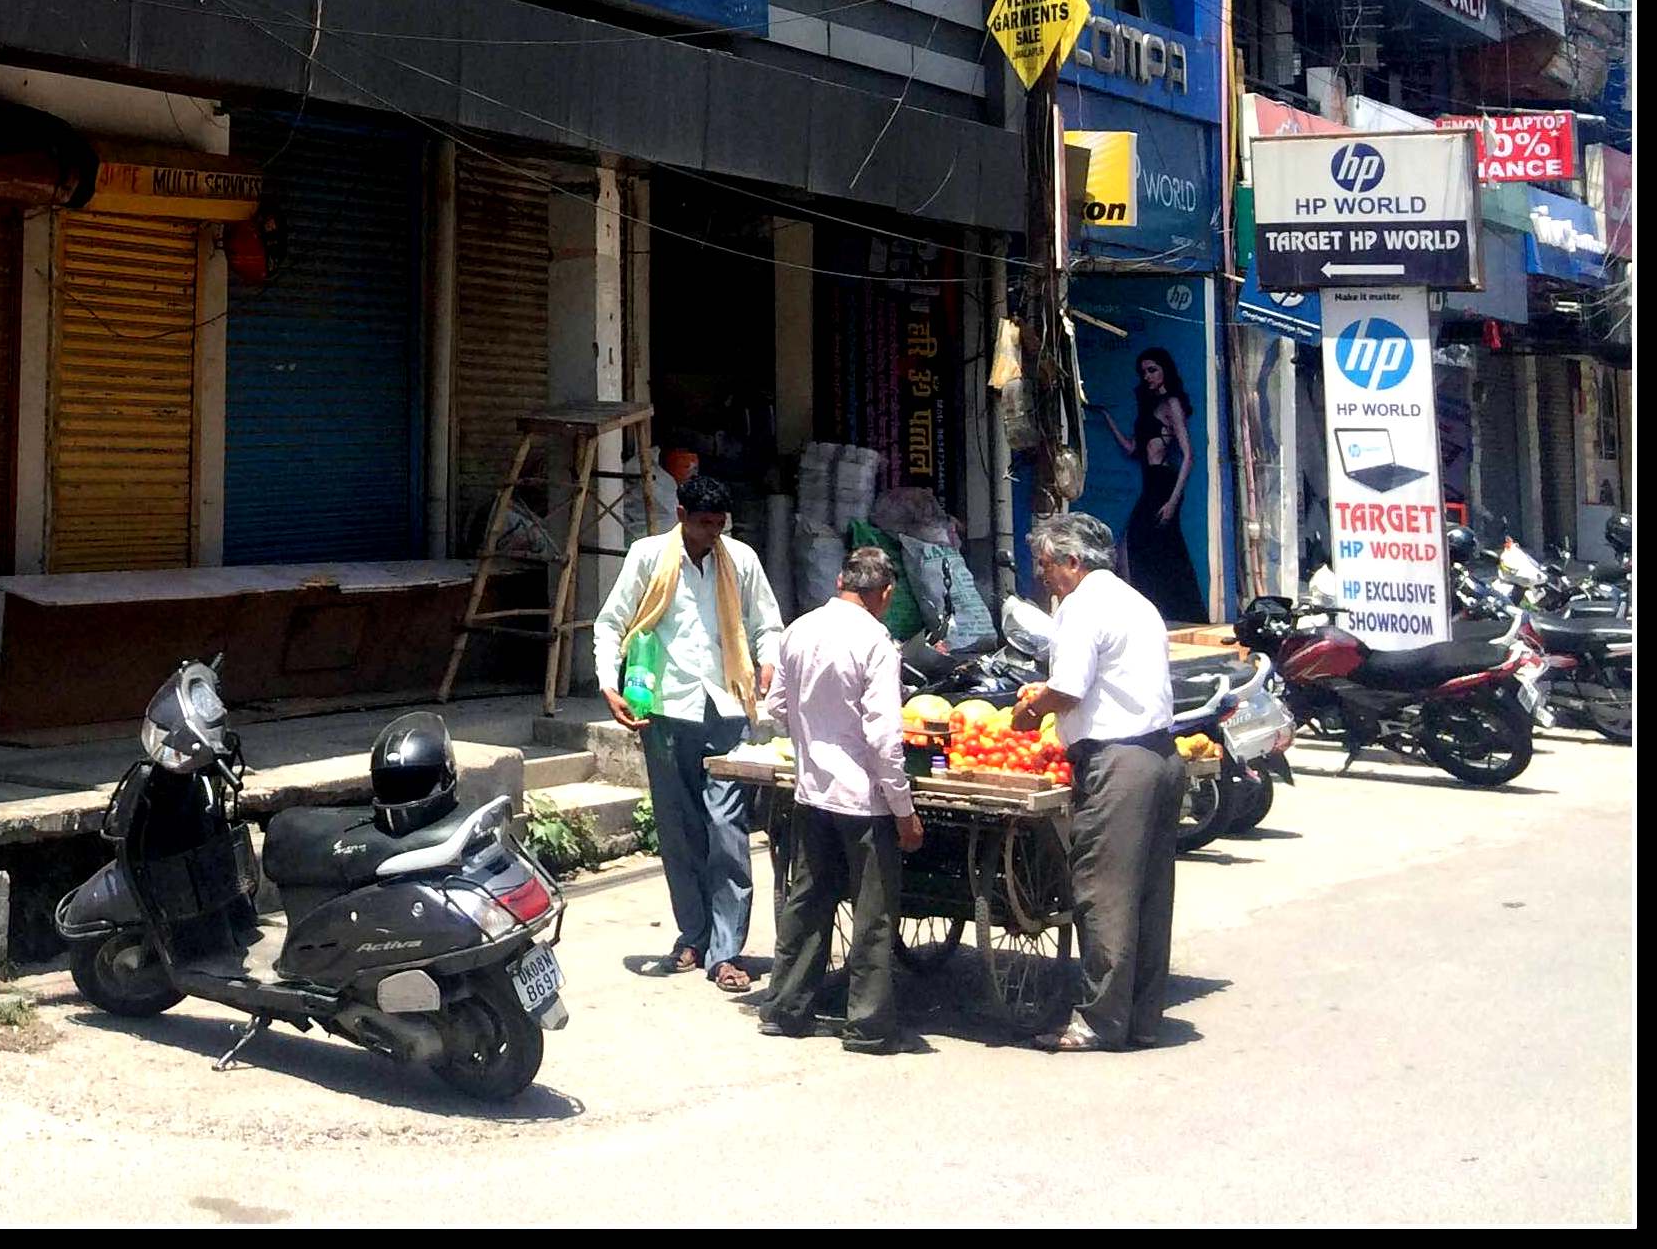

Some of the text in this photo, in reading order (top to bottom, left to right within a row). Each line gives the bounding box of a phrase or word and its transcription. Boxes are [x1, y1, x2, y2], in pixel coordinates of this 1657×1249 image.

[992, 2, 1069, 32] GARMENTS
[1016, 28, 1041, 45] SALE
[1502, 116, 1566, 131] LAPTOP
[1337, 143, 1381, 193] hp
[1143, 169, 1196, 212] WORLD
[1296, 196, 1426, 215] HP WORLD
[1266, 230, 1460, 252] TARGET HP WORLD
[1344, 318, 1407, 390] hp
[1337, 403, 1421, 417] HP WORLD
[1335, 502, 1436, 534] TARGET
[1339, 541, 1436, 562] HP WORLD
[1342, 581, 1436, 604] HP EXCLUSIVE
[1349, 611, 1433, 635] SHOWROOM
[356, 938, 422, 952] Activa
[526, 969, 560, 1002] 8697
